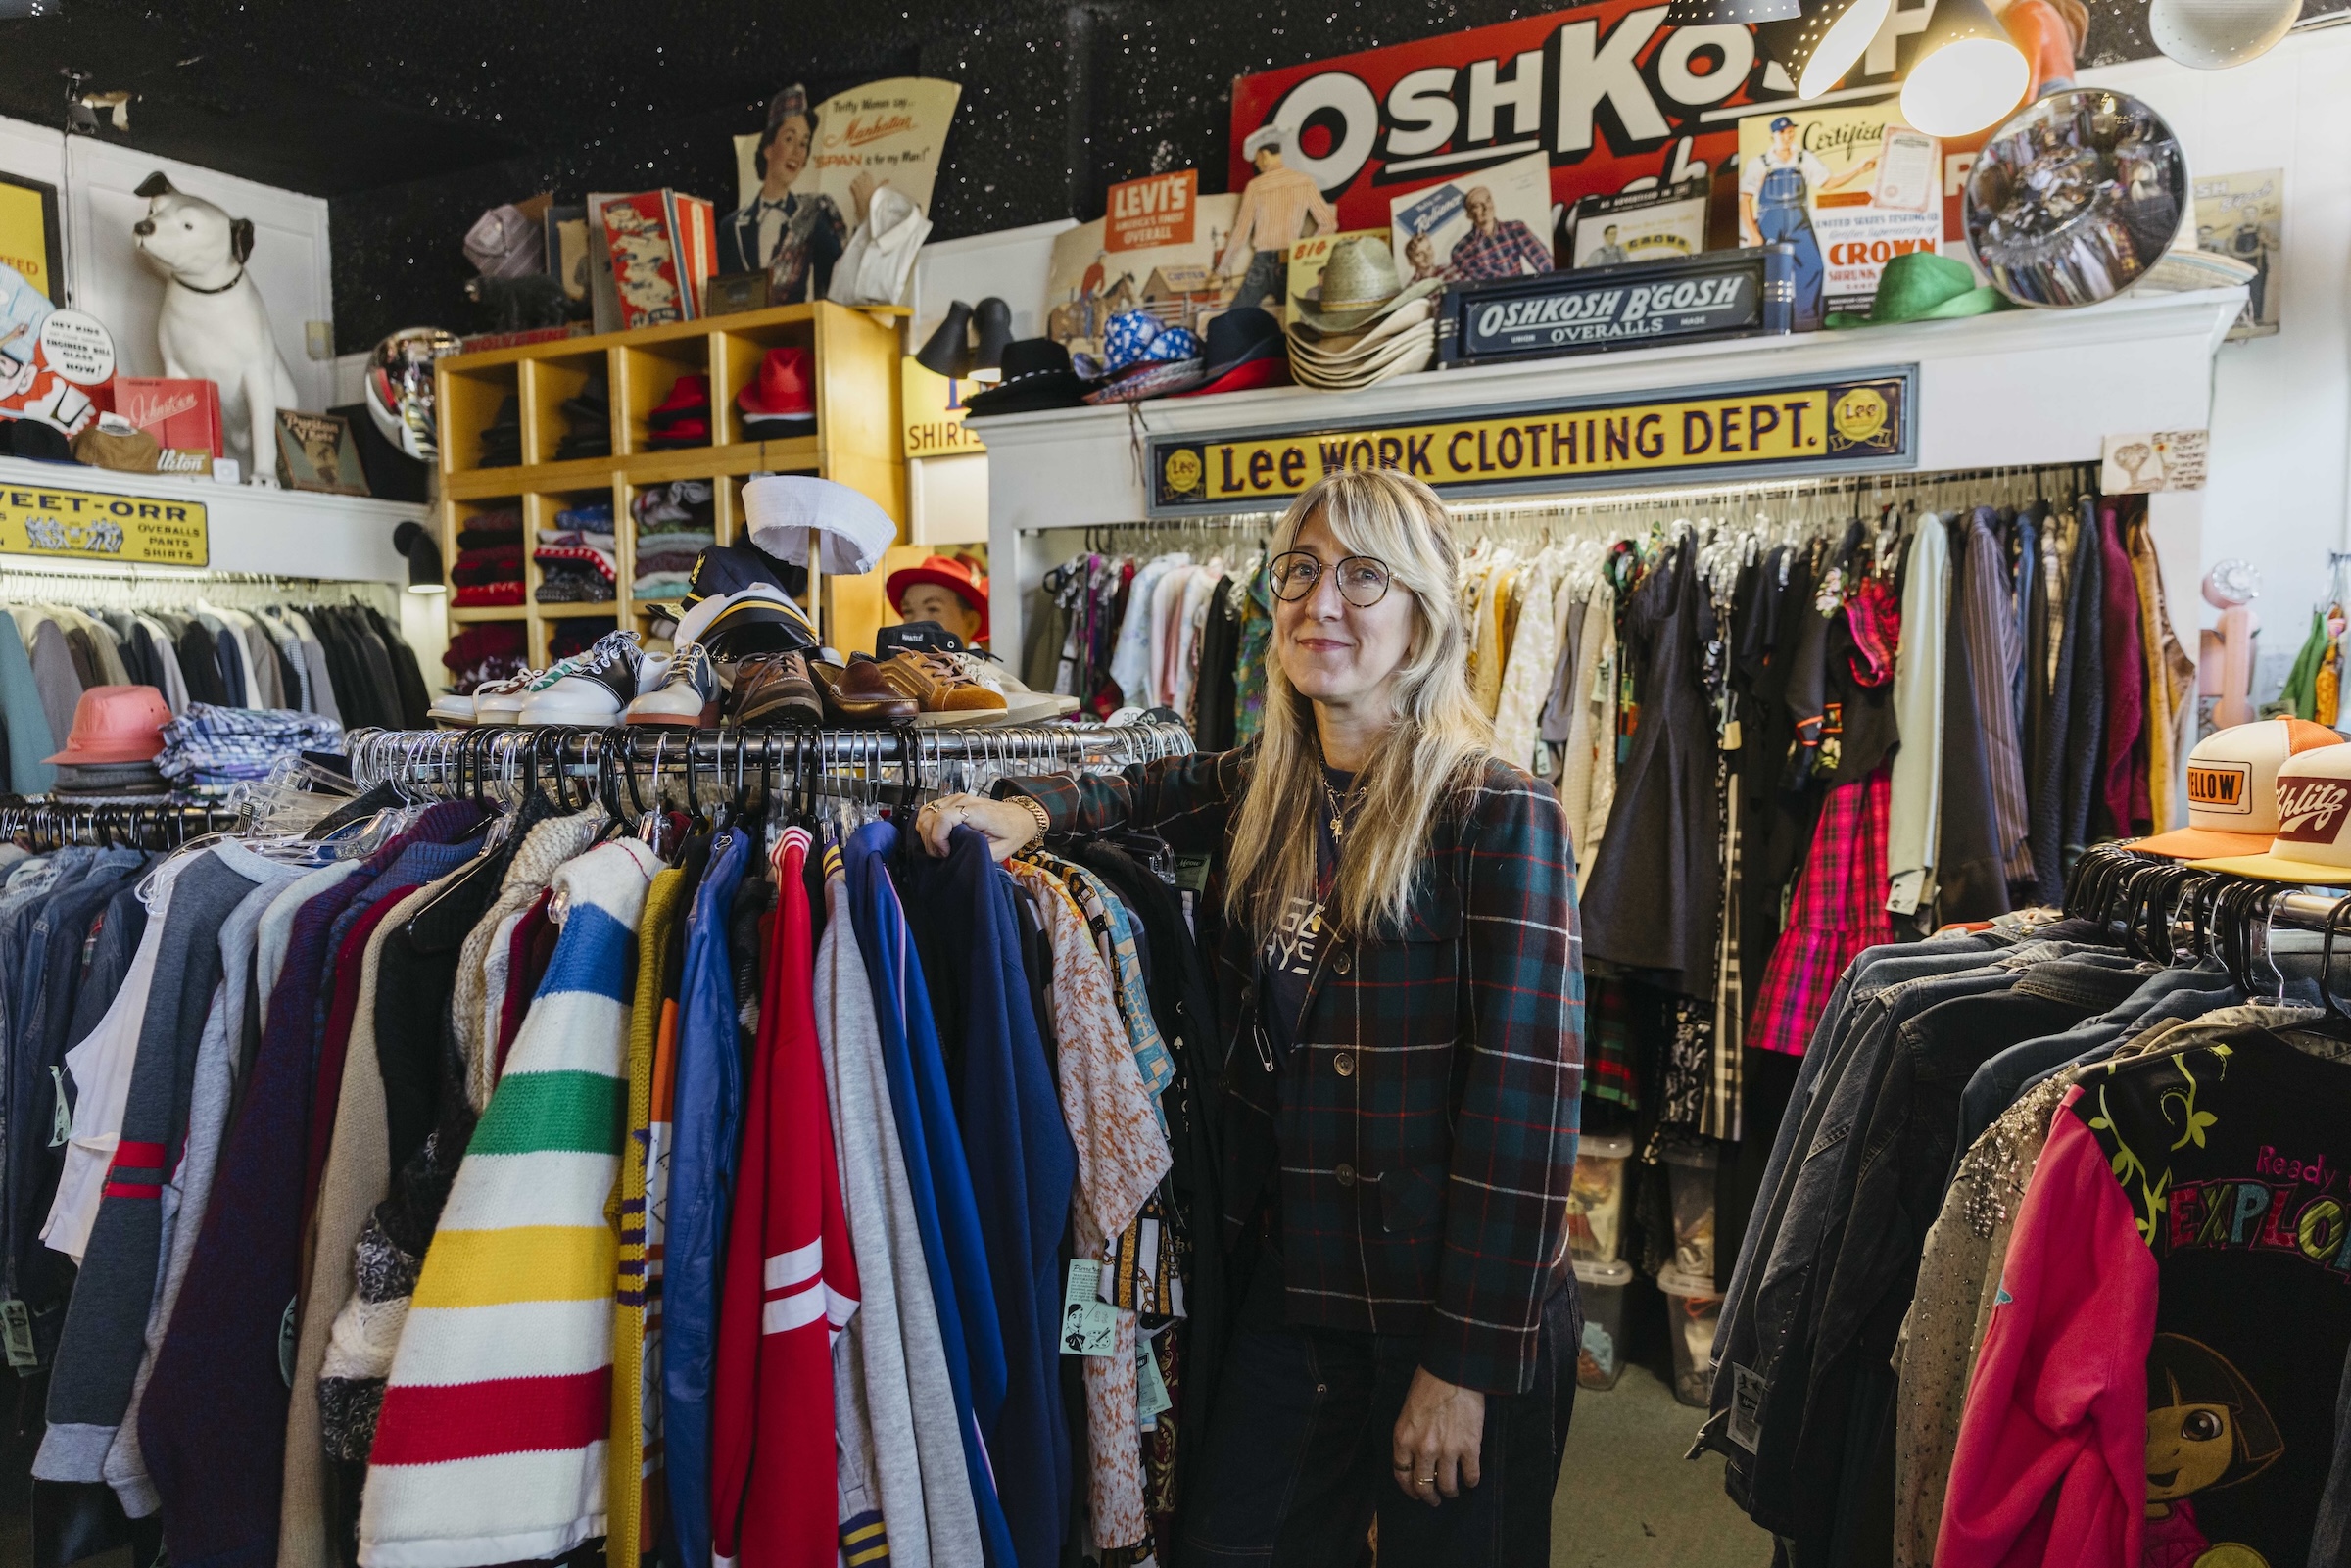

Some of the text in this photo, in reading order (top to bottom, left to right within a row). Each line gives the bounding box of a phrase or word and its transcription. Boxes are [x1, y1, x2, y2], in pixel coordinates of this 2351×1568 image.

[1115, 175, 1188, 219] LEVI'S
[1829, 238, 1936, 266] CROWN
[1477, 276, 1744, 338] OSHKOSH B'GOSH
[1511, 315, 1707, 344] UNION OVERALLS MADE
[1221, 401, 1817, 493] Lee WORK CLOTHING DEPT.
[0, 491, 187, 522] EET-ORR
[137, 523, 200, 537] OVERALLS
[149, 537, 189, 548] PANTS
[143, 548, 193, 560] SHIRTS
[2256, 1144, 2340, 1194] Ready
